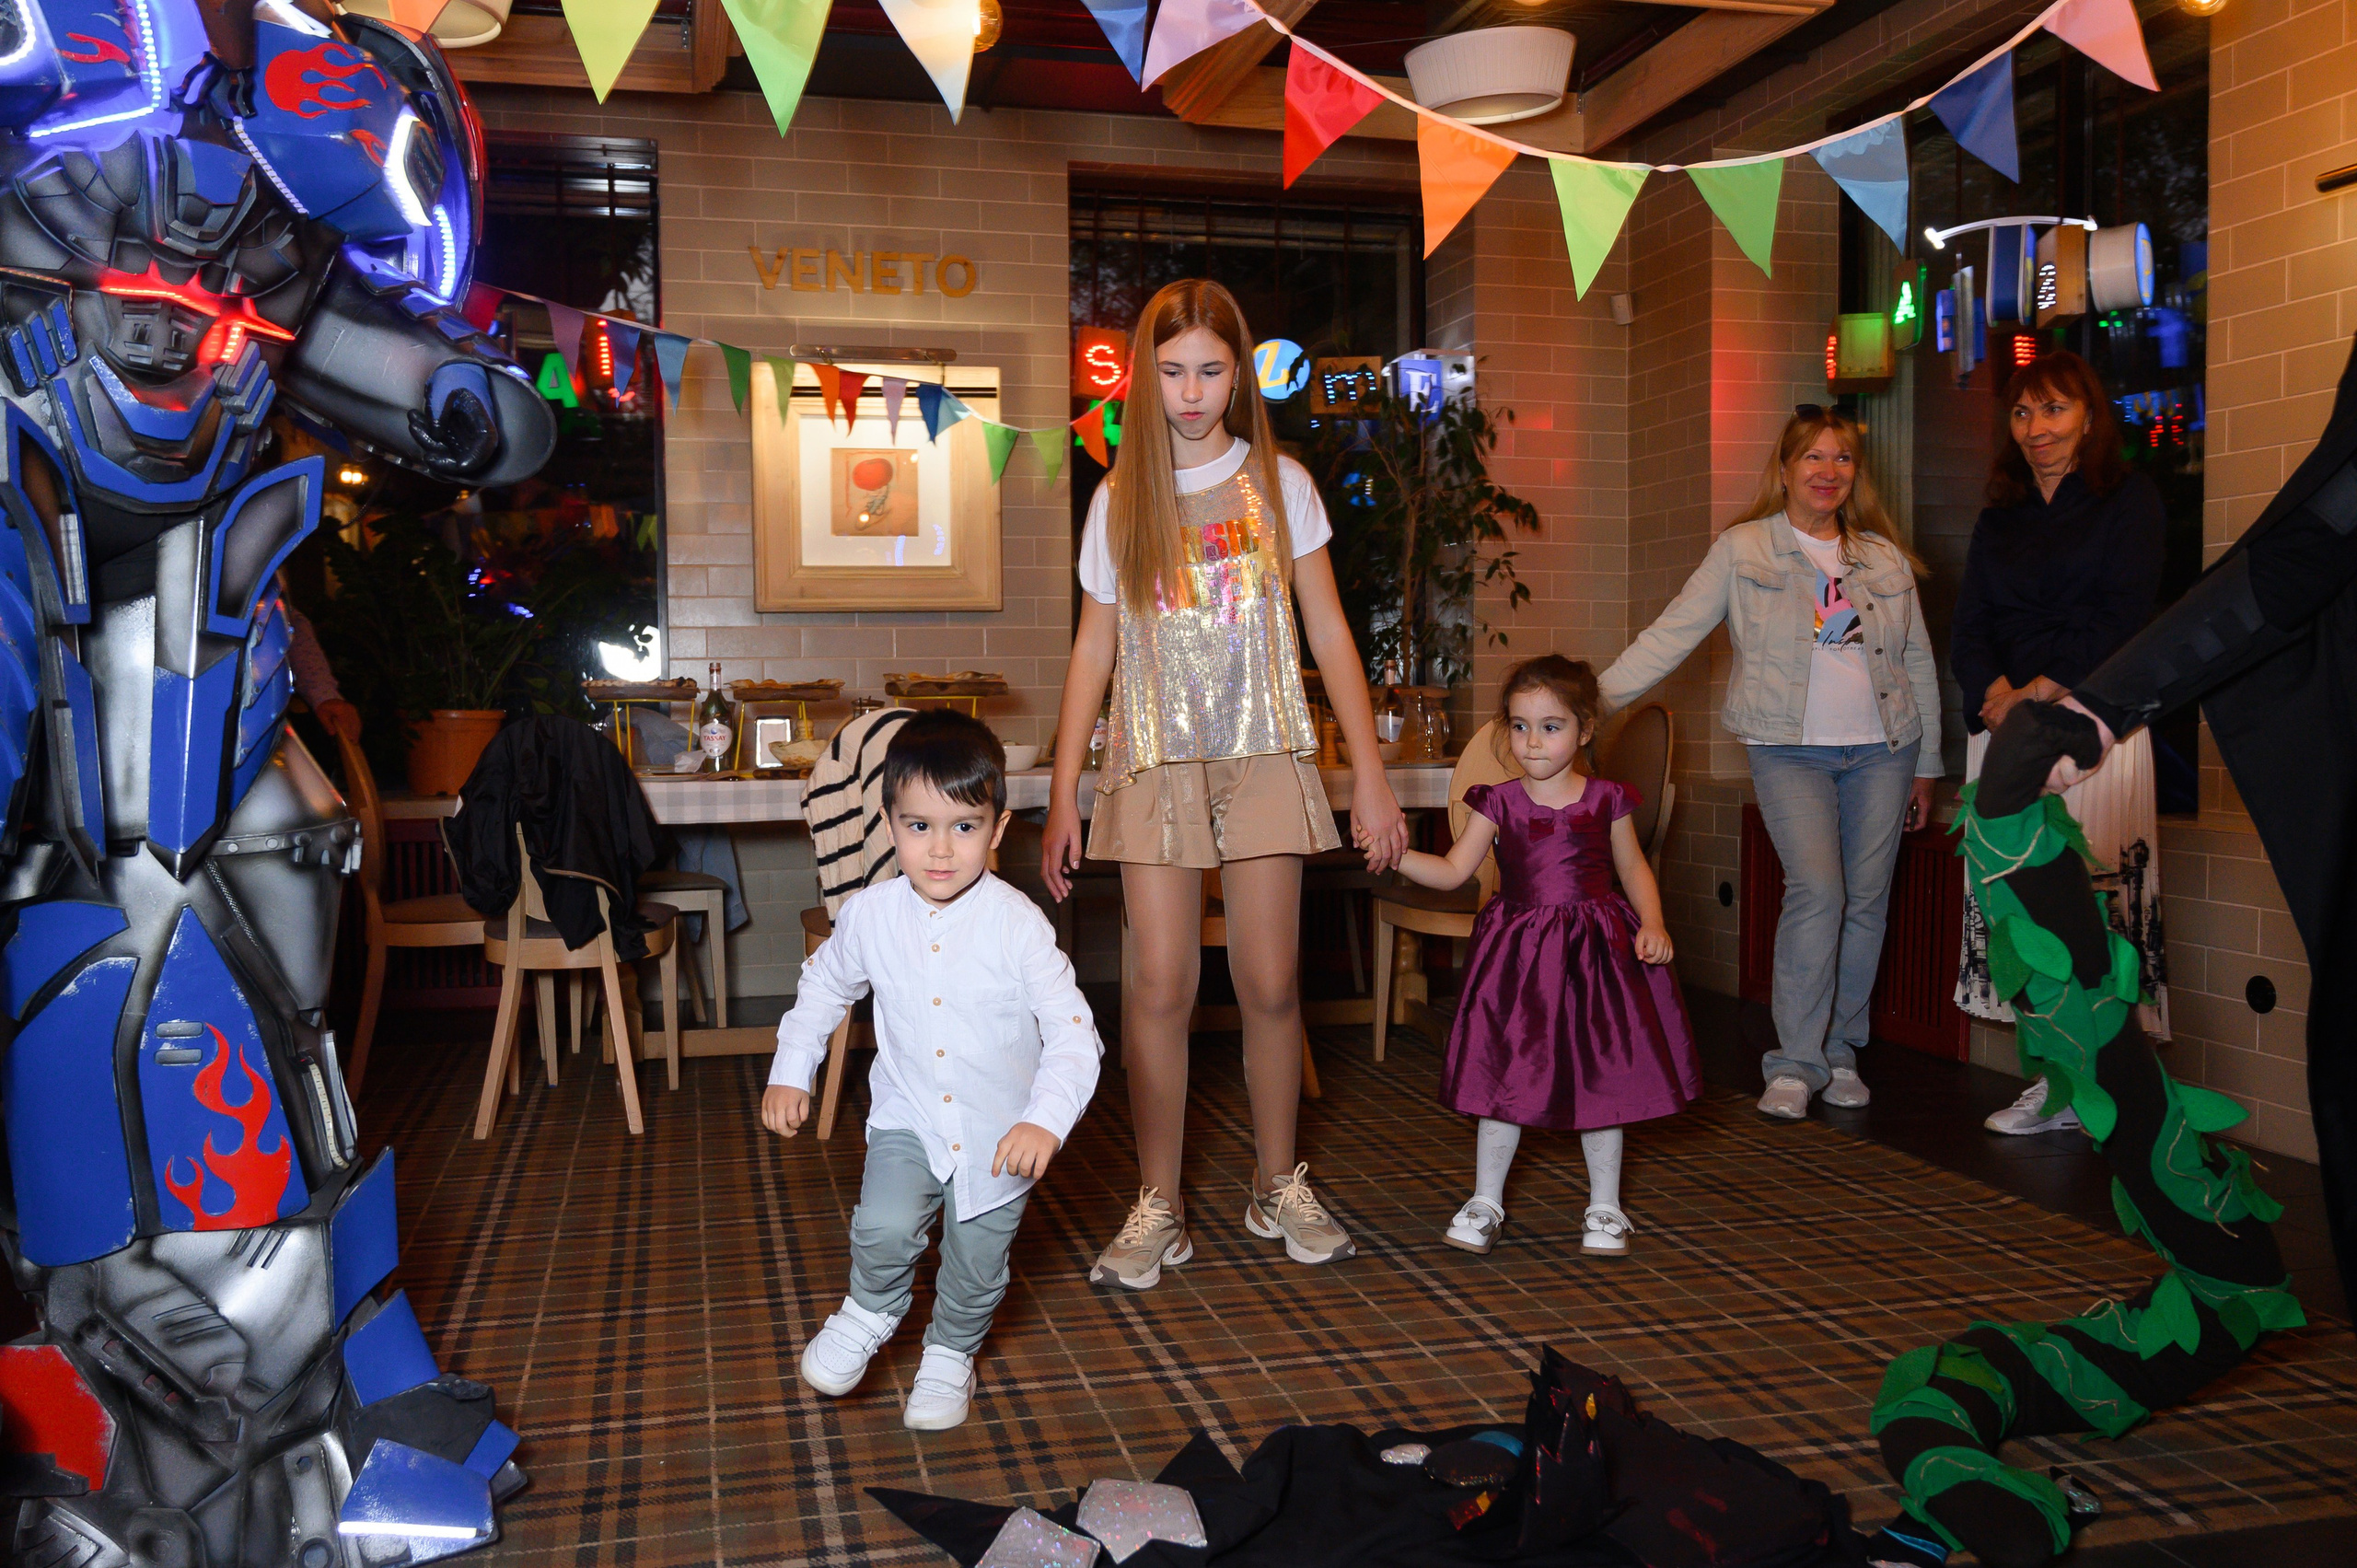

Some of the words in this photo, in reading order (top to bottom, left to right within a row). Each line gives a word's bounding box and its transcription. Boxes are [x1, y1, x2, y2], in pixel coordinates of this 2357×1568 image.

[748, 246, 977, 297] VENETO
[536, 352, 580, 409] A
[1085, 344, 1121, 385] S
[1253, 341, 1290, 389] Z
[1405, 370, 1439, 413] E
